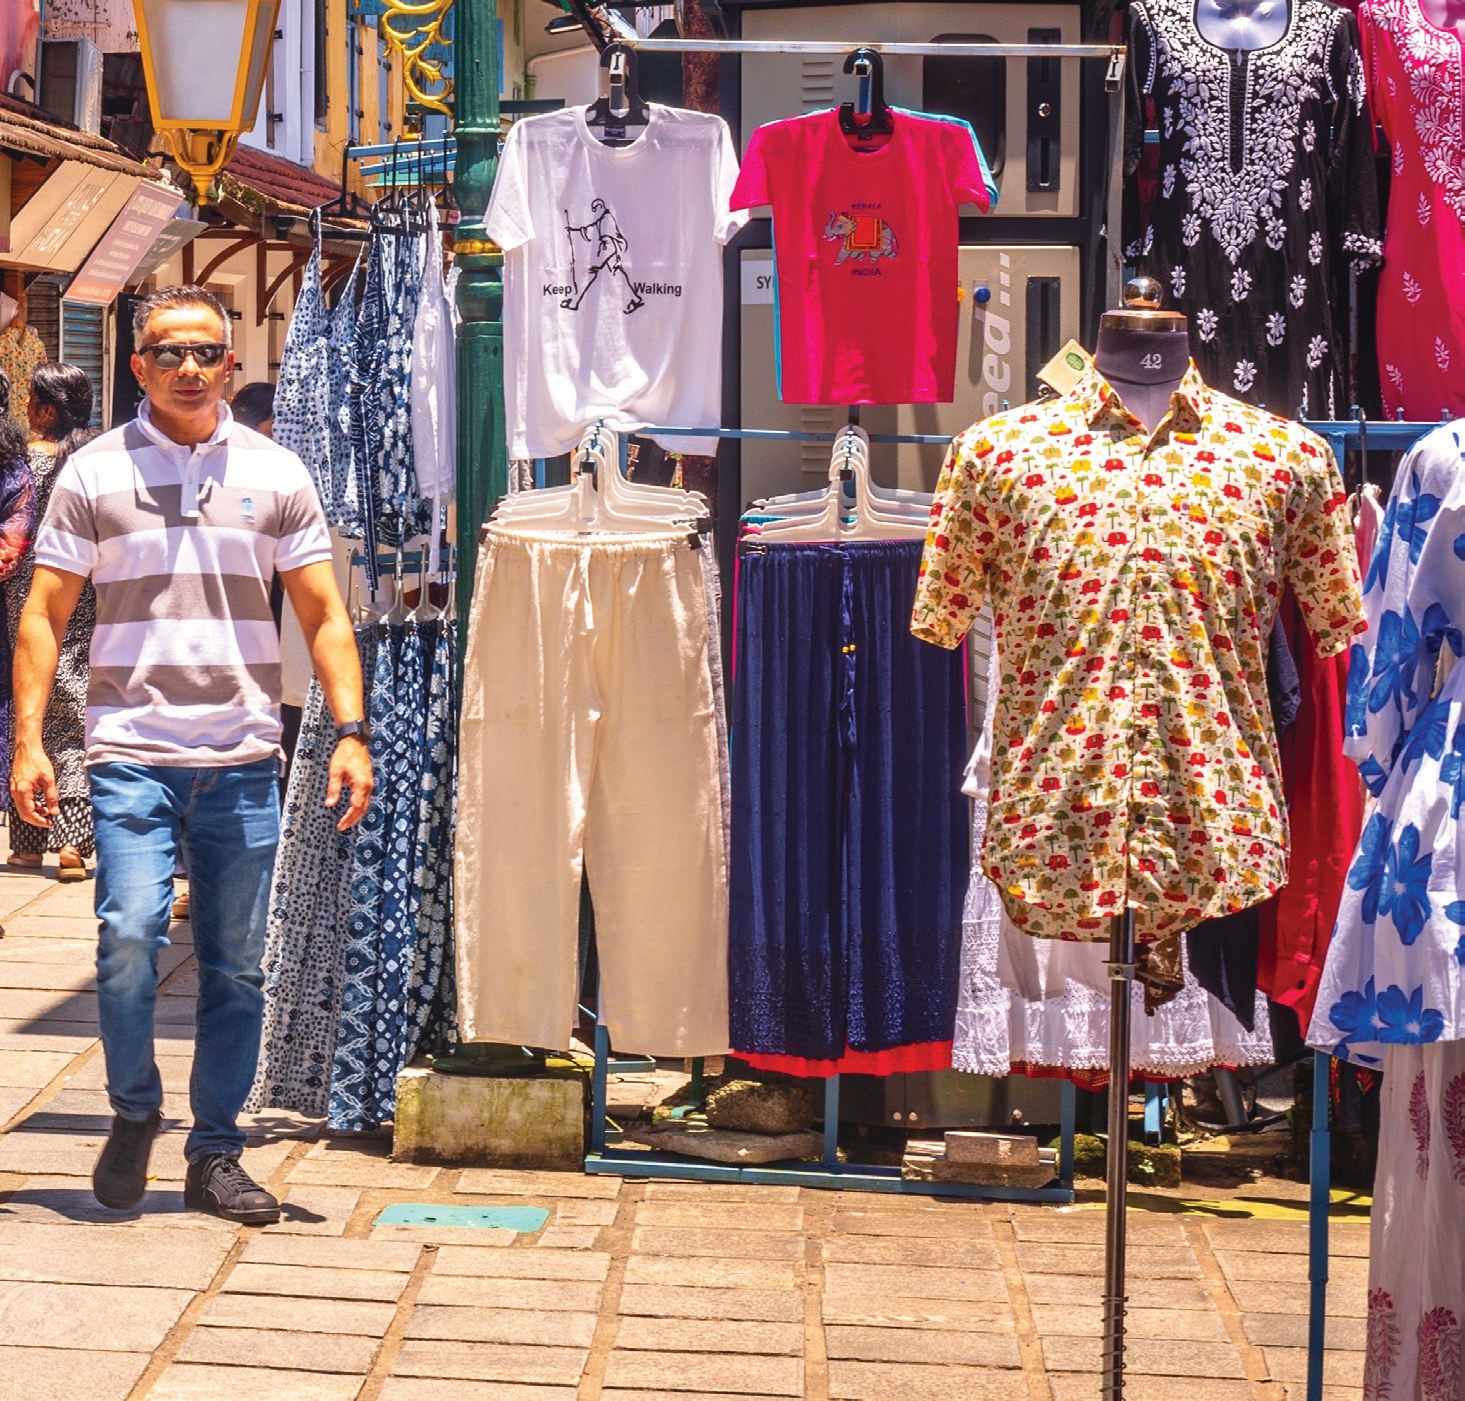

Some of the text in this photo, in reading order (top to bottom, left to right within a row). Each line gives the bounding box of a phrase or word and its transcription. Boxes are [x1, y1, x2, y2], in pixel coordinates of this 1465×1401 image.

[851, 202, 882, 210] KERALA
[851, 268, 882, 276] INDIA
[543, 282, 682, 297] Keep Walking
[1140, 353, 1162, 369] 42
